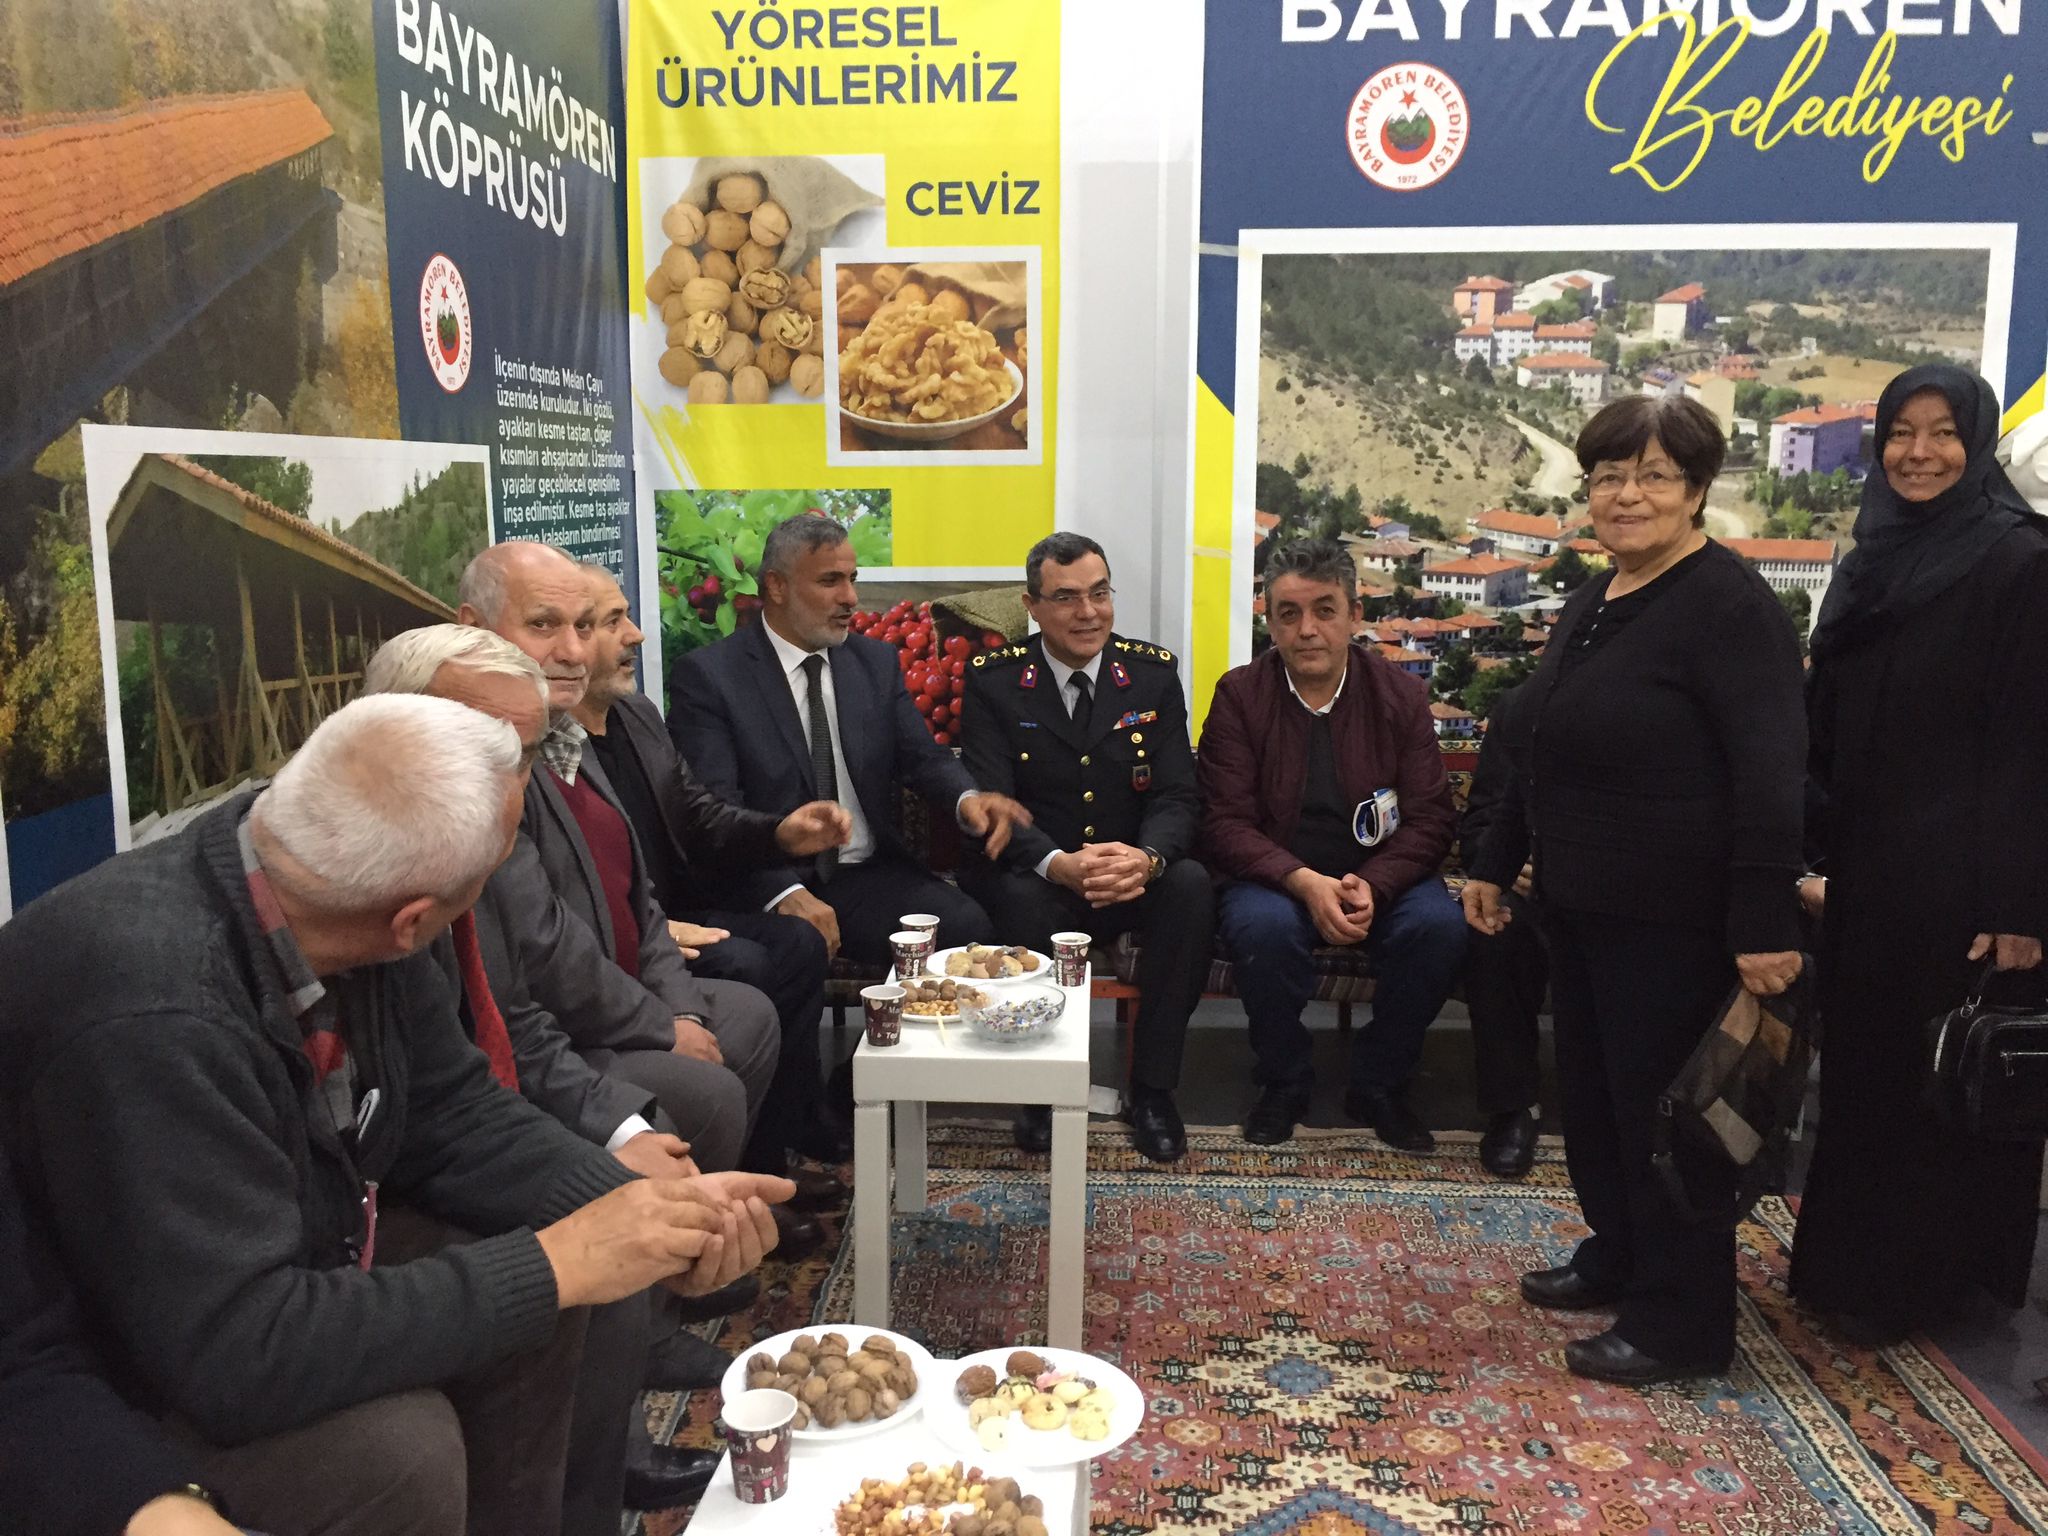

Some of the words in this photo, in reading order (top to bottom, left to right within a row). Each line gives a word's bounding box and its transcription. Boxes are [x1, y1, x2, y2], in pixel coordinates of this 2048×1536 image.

[711, 0, 958, 50] YÖRESEL
[395, 0, 617, 183] BAYRAMÖREN
[656, 51, 1018, 108] ÜRÜNLERİMİZ
[1585, 9, 2014, 192] Belediyesi
[400, 86, 567, 237] KÖPRÜSÜ
[905, 171, 1041, 217] CEVİZ
[494, 347, 528, 383] İlçenin
[496, 383, 539, 410] üzerinde
[498, 415, 537, 441] ayakları
[537, 418, 566, 440] kesme
[501, 472, 537, 499] yayalar
[503, 500, 524, 528] inşa
[568, 500, 595, 519] Kesme
